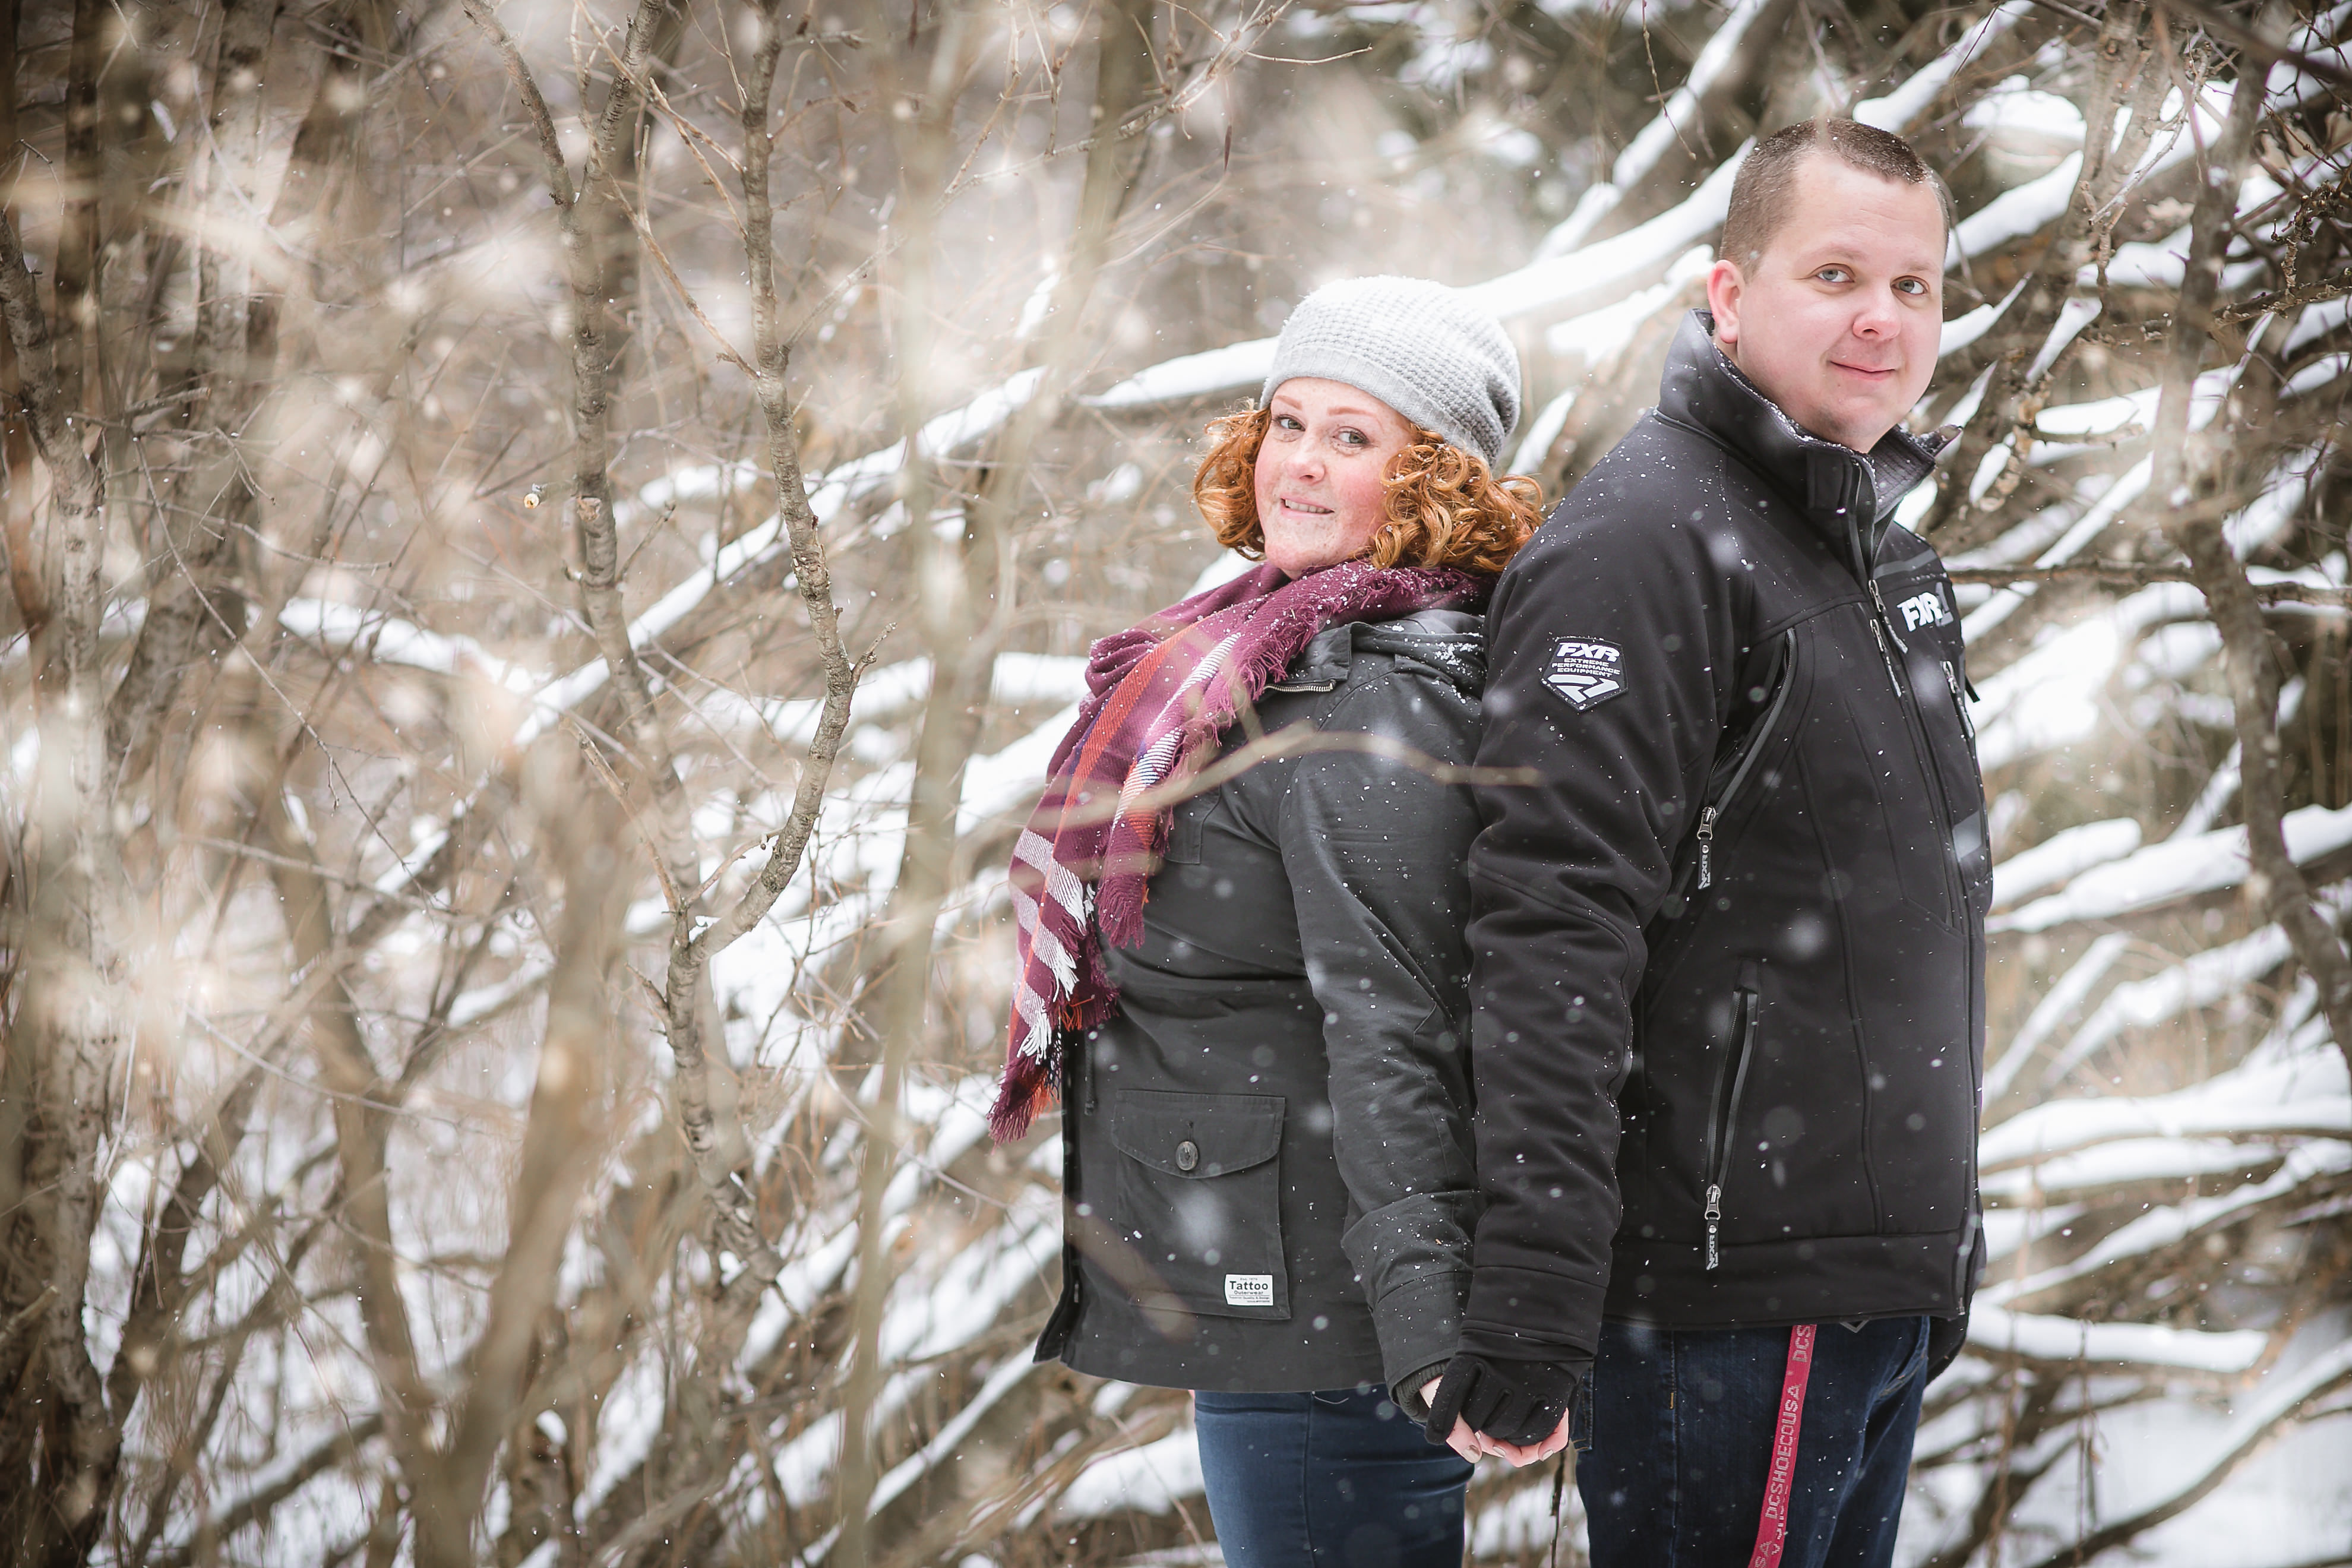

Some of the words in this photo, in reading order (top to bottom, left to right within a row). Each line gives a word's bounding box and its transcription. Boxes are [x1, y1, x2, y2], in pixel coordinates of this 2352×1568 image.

[1896, 592, 1943, 632] FXR
[1556, 642, 1620, 662] FXR
[1564, 657, 1610, 667] EXTREME
[1551, 663, 1621, 675] PERFORMANCE
[1557, 668, 1612, 677] EQUIPMENT
[1229, 1281, 1268, 1290] Tattoo
[1765, 1384, 1801, 1519] DCSHOECOUSA
